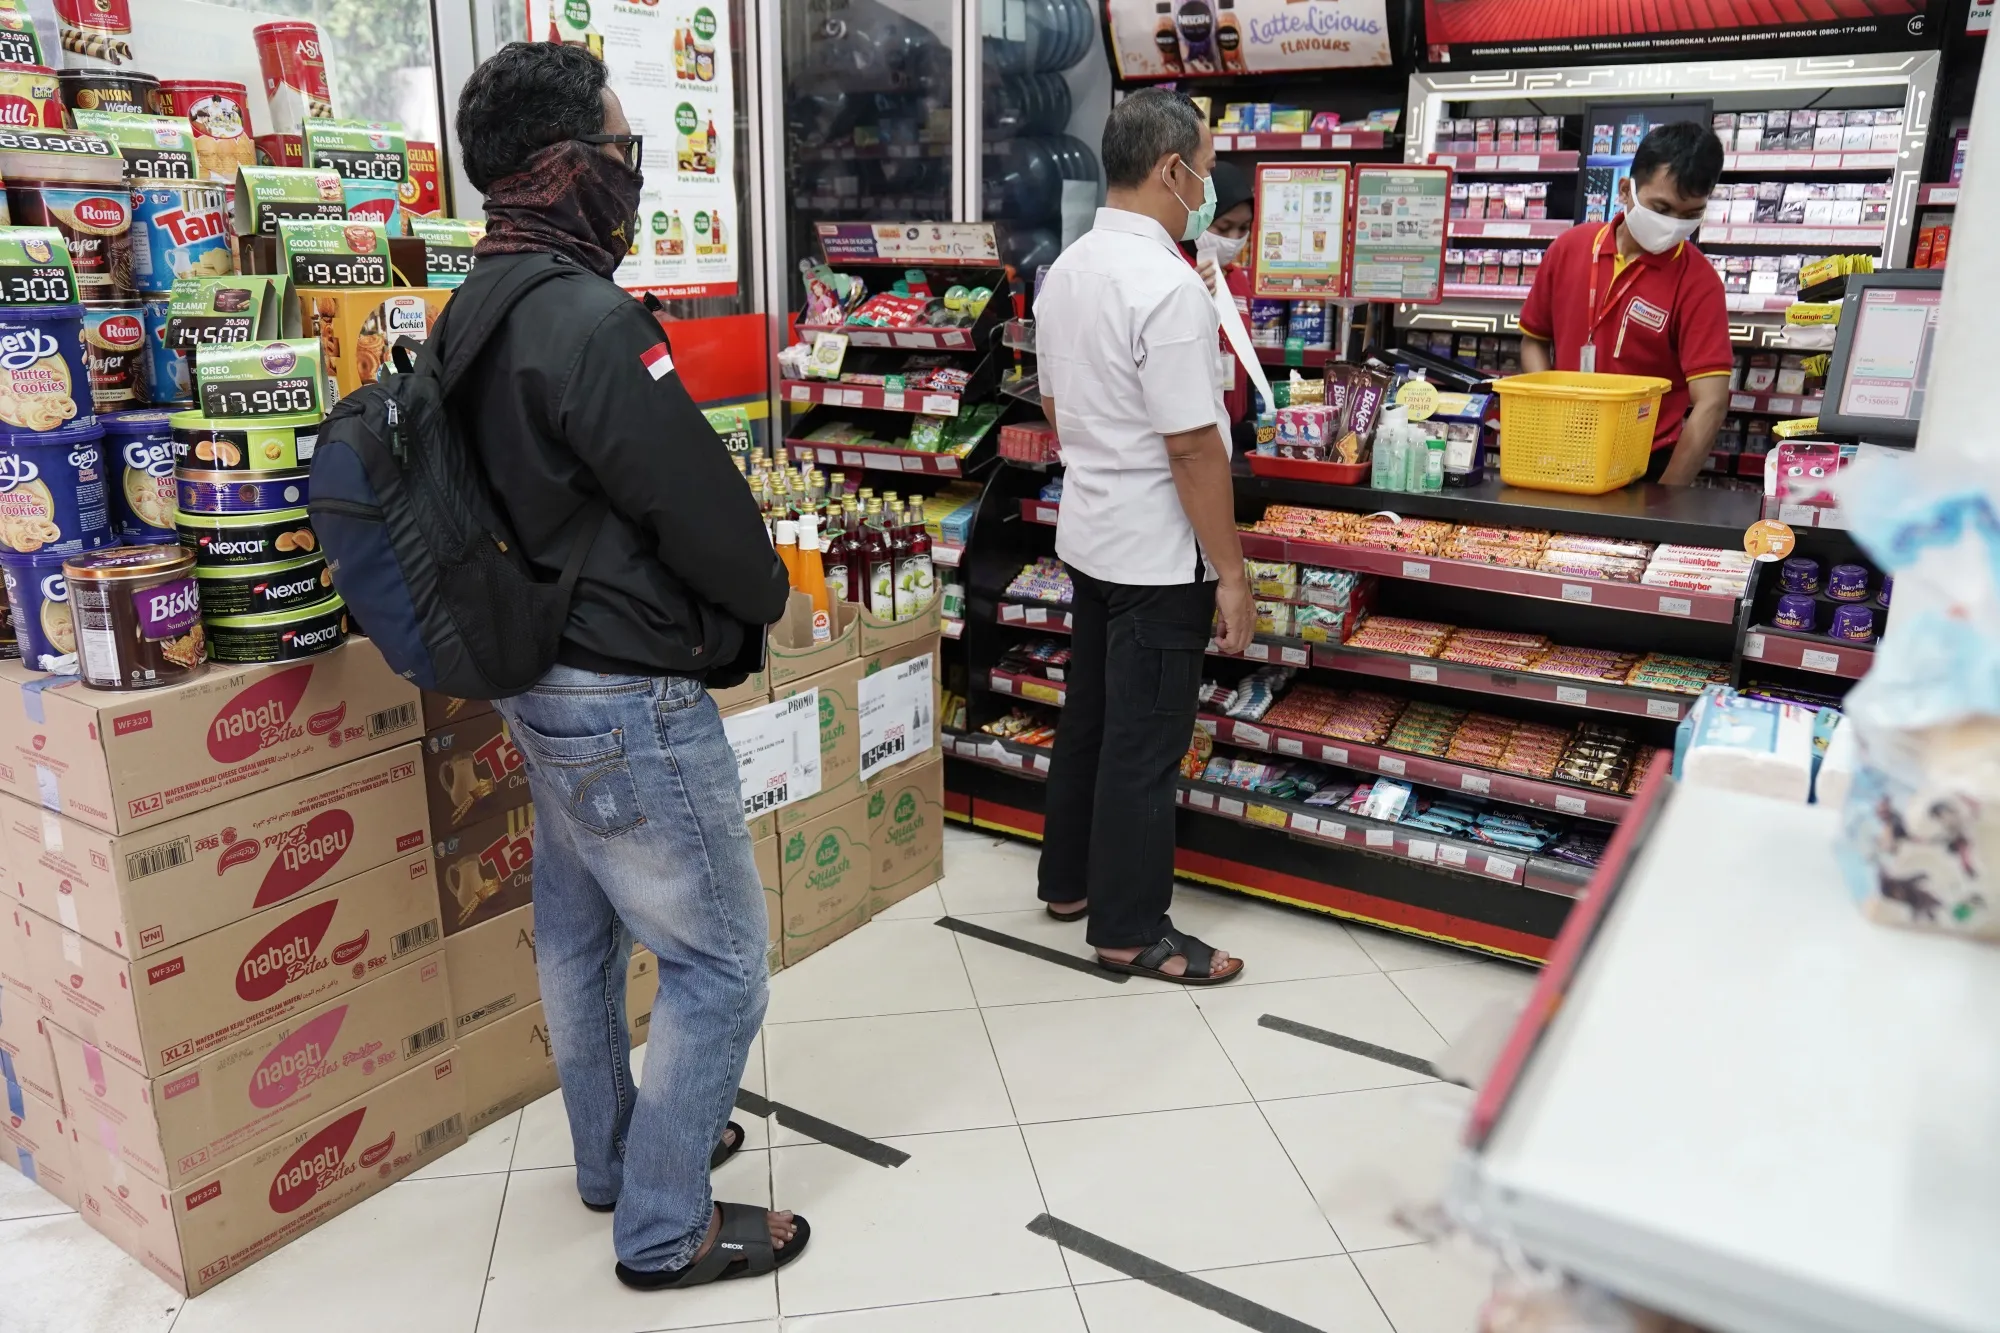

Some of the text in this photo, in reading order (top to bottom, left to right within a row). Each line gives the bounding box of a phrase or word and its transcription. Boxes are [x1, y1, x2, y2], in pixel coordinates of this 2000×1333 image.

[1281, 39, 1351, 55] FLAVOURS
[1574, 43, 1590, 51] SAYA
[1591, 42, 1621, 50] TERKENA
[1708, 35, 1740, 43] LAYANAN
[1741, 32, 1778, 41] BERHENTI
[1780, 30, 1817, 39] MEROKOK
[93, 89, 132, 102] NISSIN
[105, 102, 142, 114] Wafers
[313, 135, 344, 145] NABATI
[408, 149, 434, 162] GUAN
[256, 188, 285, 196] TANGO
[81, 206, 121, 221] Roma
[289, 240, 339, 248] GOOD TIME
[419, 233, 453, 241] RICHEESE
[308, 264, 384, 285] 19.900
[1801, 266, 1825, 278] Antangin
[172, 302, 207, 310] SELAMAT
[1633, 303, 1662, 321] Alfamart
[225, 318, 250, 326] 20.500
[1792, 313, 1821, 321] Antangin
[106, 324, 139, 338] Roma
[11, 370, 51, 381] Butter
[201, 366, 229, 375] OREO
[13, 381, 65, 393] Cookies
[277, 380, 308, 388] 32.900
[219, 389, 311, 414] 17.900
[1355, 389, 1376, 434] Biskies
[1, 504, 46, 516] Cookies
[1286, 513, 1308, 522] chunky
[1276, 526, 1298, 535] chunky
[1370, 527, 1414, 539] chunky bar
[1477, 529, 1521, 541] chunky bar
[1364, 541, 1388, 550] chunky
[1462, 551, 1508, 564] chunky bar
[908, 658, 929, 676] PROMO
[788, 693, 814, 714] PROMO
[117, 716, 149, 729] WF320
[215, 699, 285, 742] nabati
[261, 723, 305, 750] Bites
[164, 756, 277, 798] WAFER KRIM KEJU/ CHEESE CREAM WAFER/
[393, 764, 413, 779] XL2
[132, 797, 160, 812] XL2
[894, 802, 915, 820] ABC
[1493, 810, 1526, 822] Dairy Milk
[885, 815, 924, 844] Squash
[400, 834, 421, 847] WF320
[283, 829, 347, 871] nabati
[817, 844, 839, 863] ABC
[412, 864, 425, 875] INA
[805, 857, 850, 890] Squash
[143, 930, 161, 944] INA
[244, 936, 311, 982] nabati
[151, 961, 181, 978] WF320
[286, 956, 329, 984] Bites
[195, 1034, 215, 1046] WAFER
[215, 1027, 230, 1039] KRIM
[246, 1011, 265, 1024] CHEESE
[265, 1003, 283, 1016] CREAM
[165, 1043, 191, 1061] XL2
[257, 1042, 322, 1091] nabati
[437, 1064, 451, 1077] INA
[167, 1076, 197, 1094] WF320
[276, 1145, 340, 1196] nabati
[316, 1162, 356, 1194] Bites
[189, 1186, 218, 1204] WF320
[231, 1247, 250, 1261] WAFER
[278, 1222, 297, 1234] CHEESE
[297, 1211, 314, 1223] CREAM
[721, 1242, 743, 1250] GEOX
[202, 1261, 226, 1281] XL2
